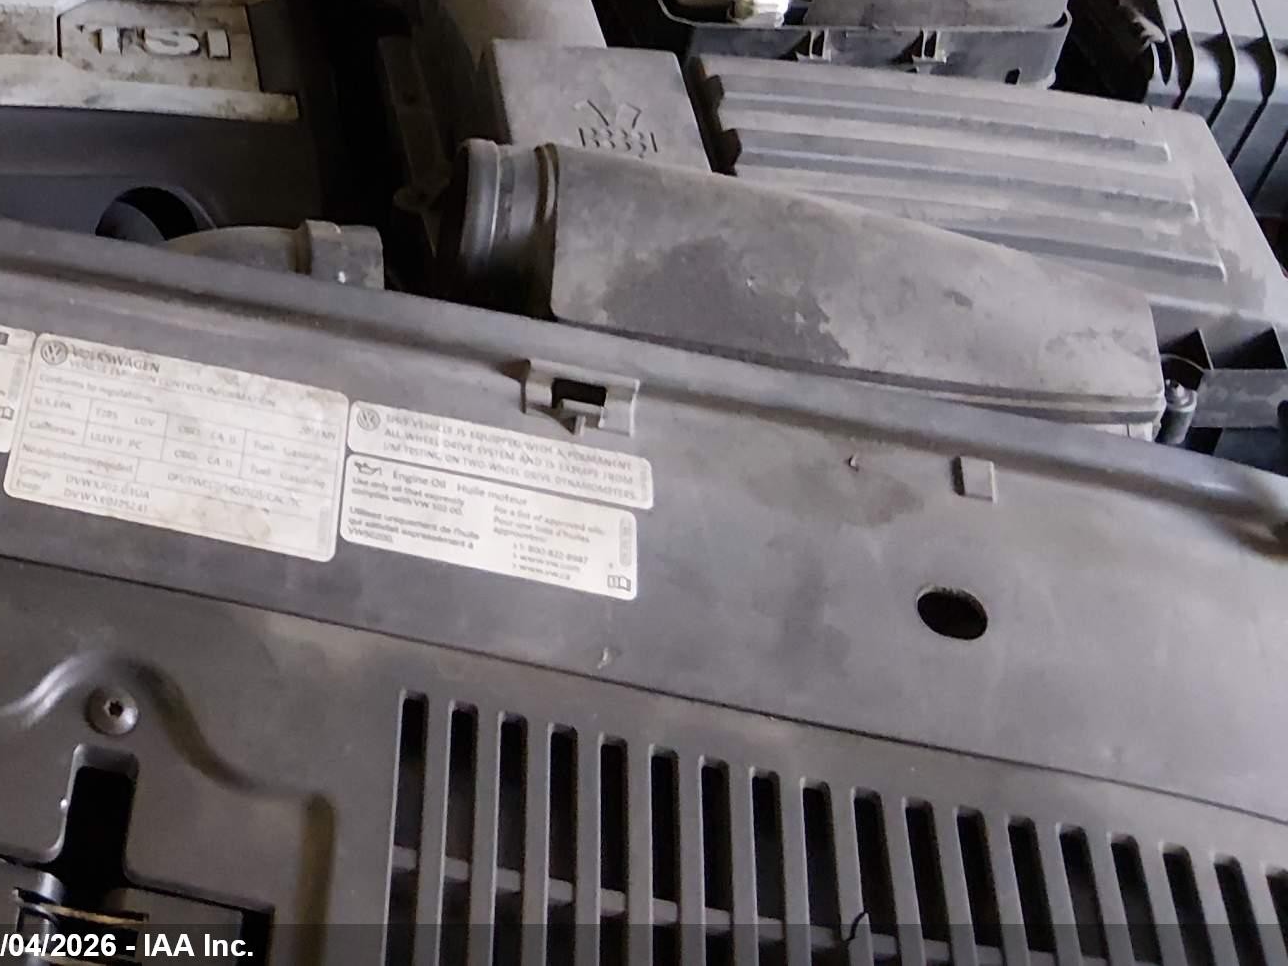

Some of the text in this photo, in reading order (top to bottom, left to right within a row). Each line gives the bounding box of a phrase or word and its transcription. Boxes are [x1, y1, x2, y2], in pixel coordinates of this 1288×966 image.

[392, 470, 428, 487] Engine
[431, 477, 447, 489] Oil
[456, 482, 485, 497] Huile
